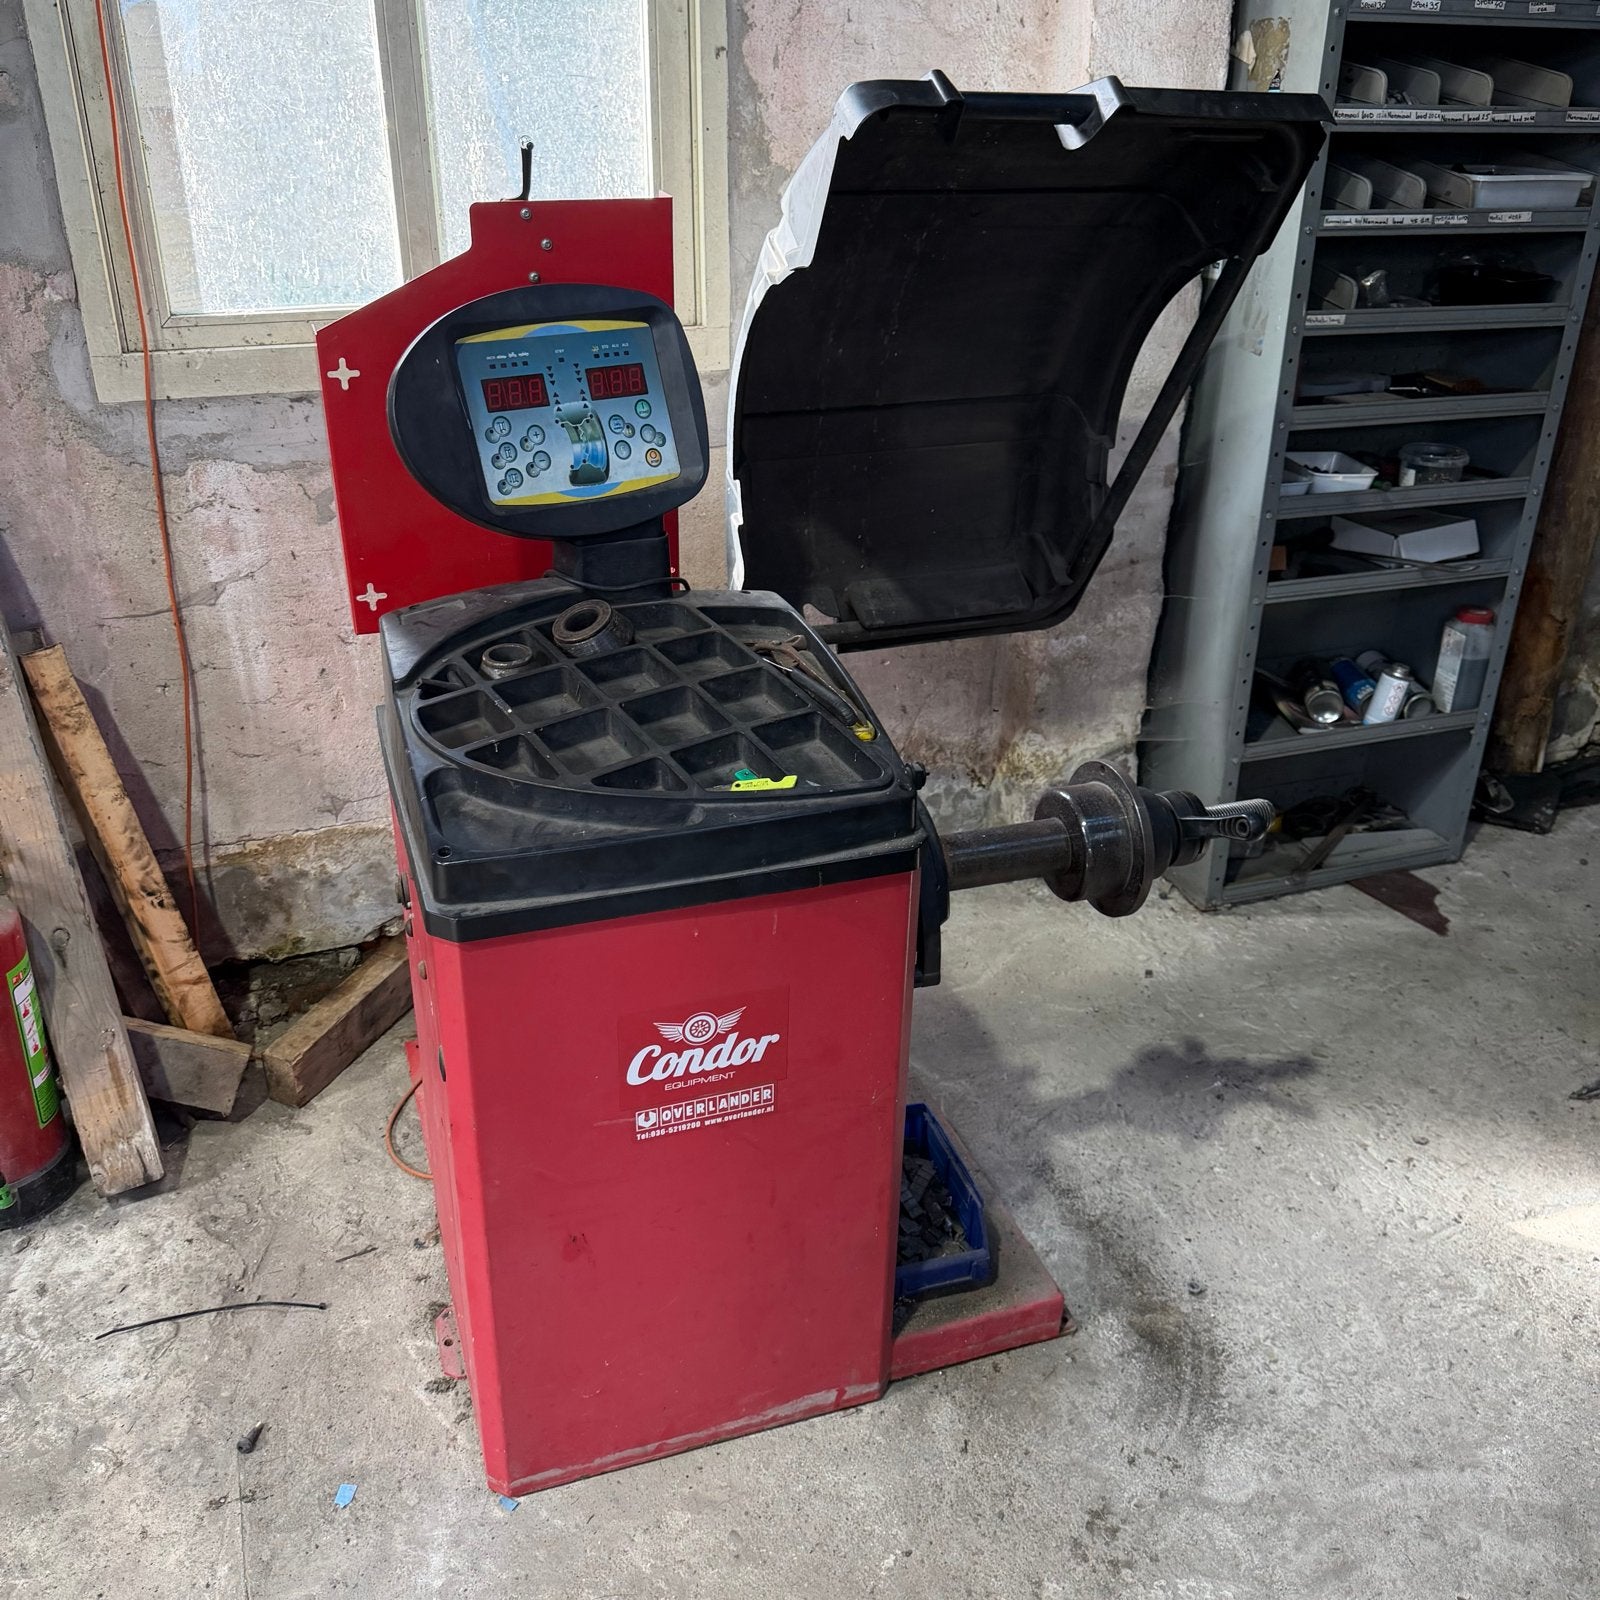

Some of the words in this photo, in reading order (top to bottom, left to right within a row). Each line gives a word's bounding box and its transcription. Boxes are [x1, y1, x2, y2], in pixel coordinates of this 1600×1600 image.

[1429, 2, 1440, 10] 35
[626, 1031, 780, 1086] Condor
[664, 1071, 736, 1091] EQUIPMENT
[661, 1088, 773, 1122] OVERLANDER
[704, 1105, 775, 1127] www.overlander.nl
